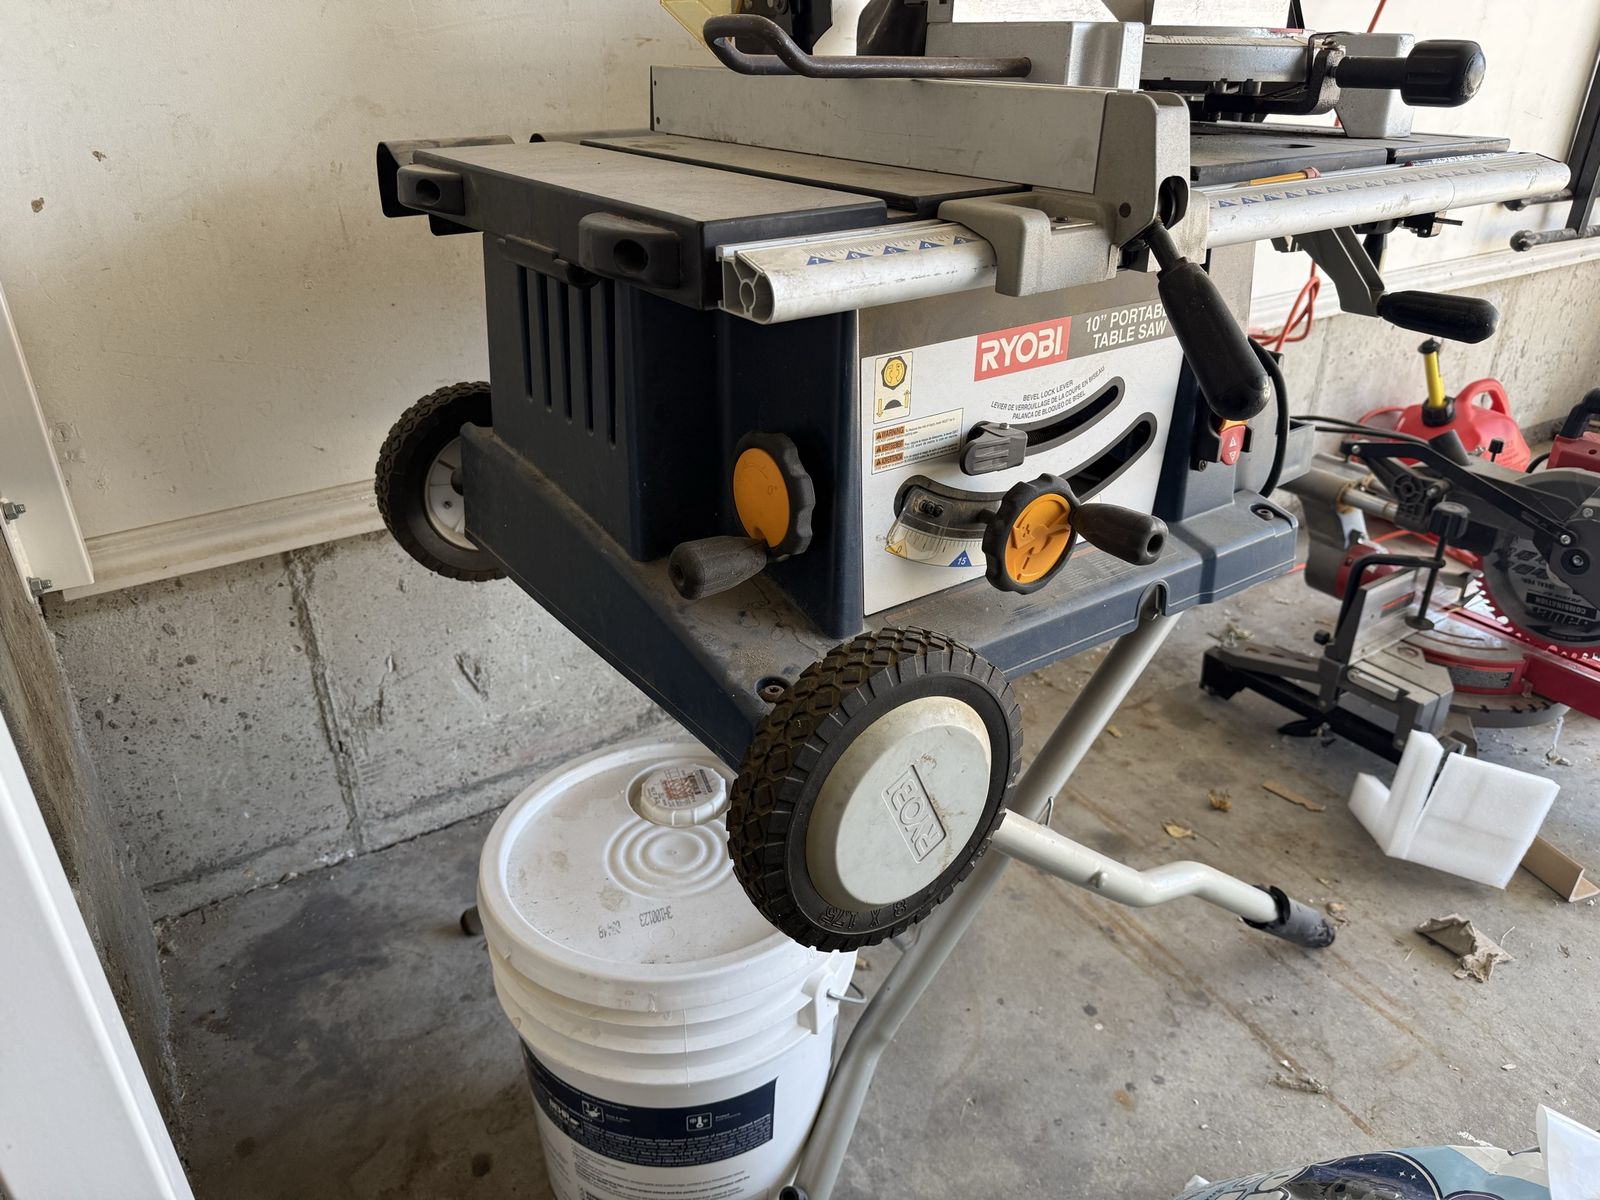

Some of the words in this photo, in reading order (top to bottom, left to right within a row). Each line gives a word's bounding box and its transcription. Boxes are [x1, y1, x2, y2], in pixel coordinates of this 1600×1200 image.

[980, 325, 1063, 373] RYOBI
[1093, 329, 1135, 350] TABLE
[1138, 319, 1168, 339] SAW
[991, 400, 1007, 410] LEVIER
[1007, 403, 1015, 411] DE
[1015, 398, 1051, 412] VERROUILLAGE
[1051, 395, 1058, 404] DE
[1059, 392, 1065, 401] LA
[1065, 385, 1081, 398] COUPE
[1081, 379, 1089, 388] EN
[1012, 411, 1034, 420] PALANCA
[1034, 409, 1041, 417] DE
[1042, 402, 1065, 416] BLOQUEO
[1065, 397, 1072, 406] DE
[1072, 390, 1086, 402] BISEL
[1023, 392, 1041, 402] BEVEL
[1041, 387, 1056, 398] LOCK
[1056, 379, 1074, 393] LEVER
[957, 556, 967, 566] 15
[1535, 596, 1586, 615] COMBINATION
[886, 770, 940, 857] RYOBI
